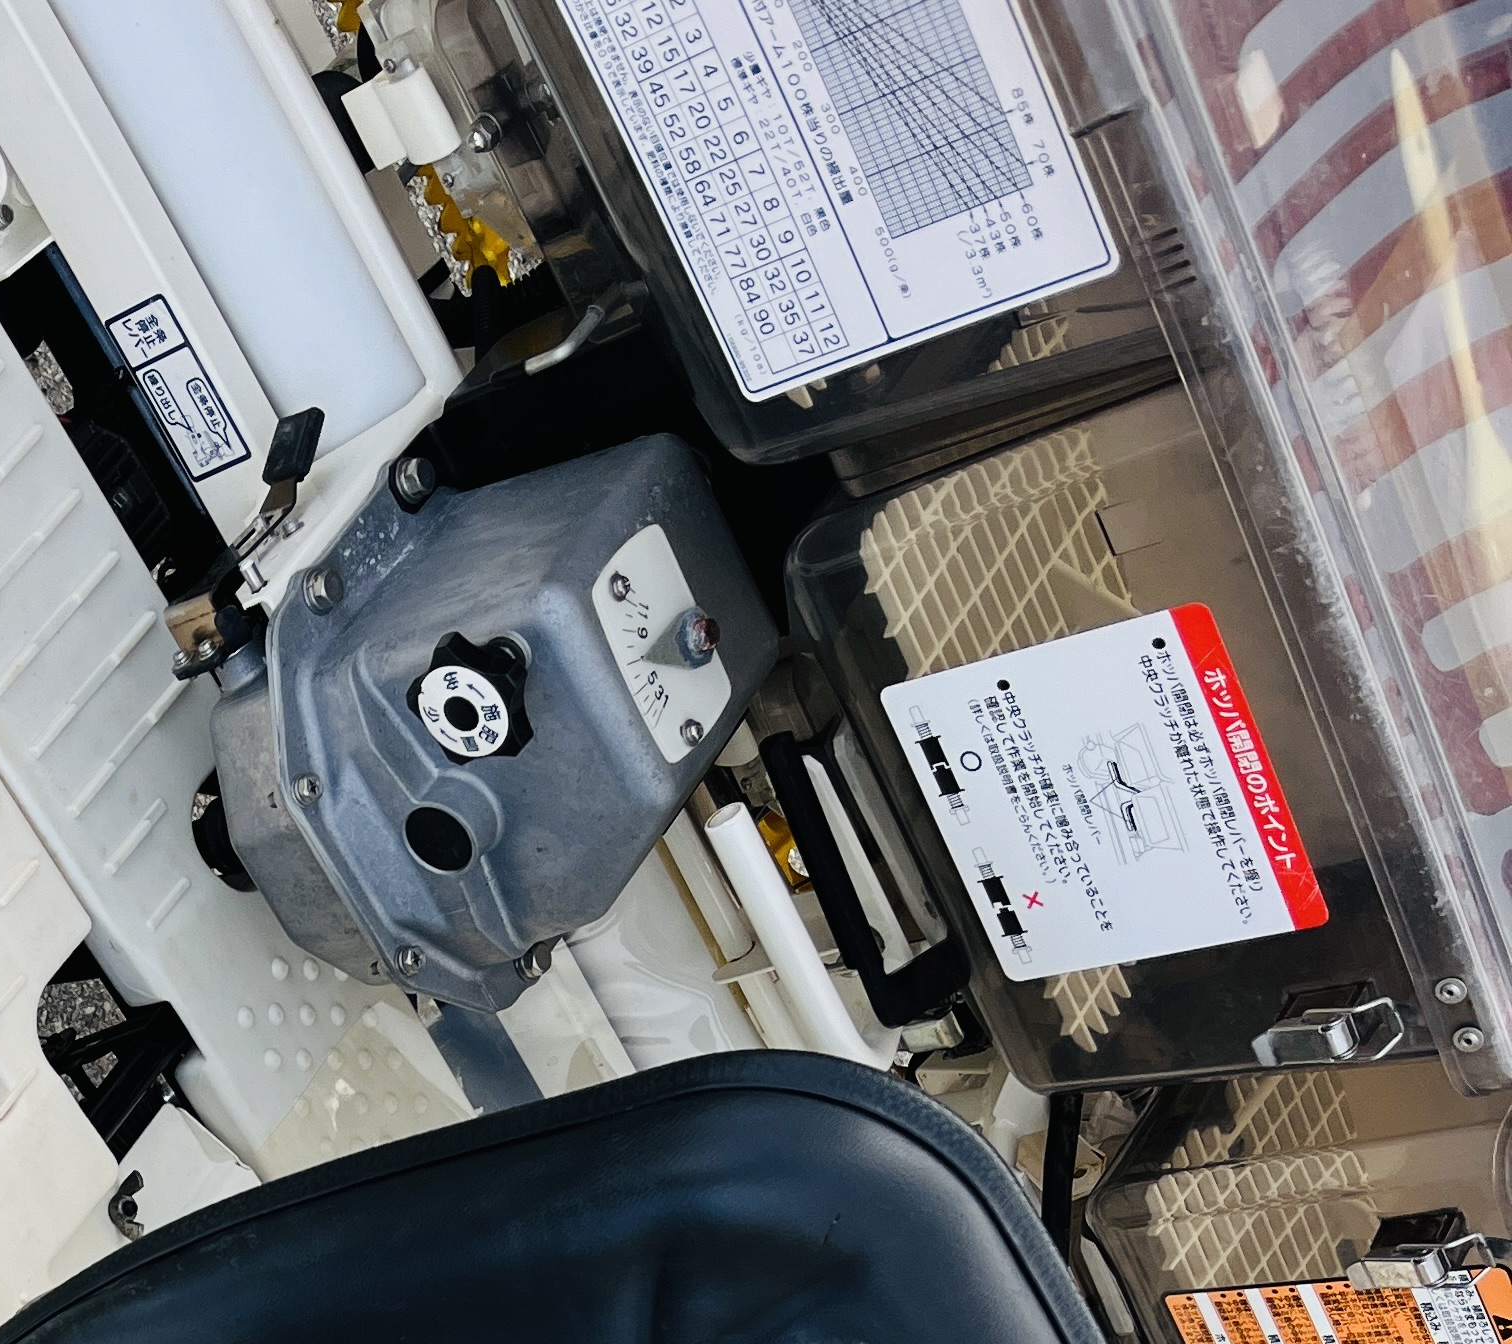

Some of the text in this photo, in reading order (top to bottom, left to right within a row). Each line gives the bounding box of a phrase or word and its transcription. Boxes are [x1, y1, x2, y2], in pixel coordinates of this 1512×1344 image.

[792, 40, 812, 71] 200
[821, 103, 840, 134] 300
[849, 166, 867, 195] 400
[1012, 88, 1054, 175] 85株 70株
[615, 12, 774, 334] 32 39 45 52 58 64 71 77 84 90
[642, 0, 814, 353] 12 15 17 20 22 25 27 30 32 35 37
[686, 29, 701, 43] 3
[703, 65, 717, 76] 4
[717, 97, 733, 110] 5
[733, 131, 748, 144] 6
[748, 163, 764, 174] 7
[763, 197, 779, 211] 8
[778, 230, 793, 243] 9
[791, 258, 811, 282] 10
[805, 291, 824, 312] 11
[819, 323, 839, 347] 12
[800, 212, 817, 236] 白色
[986, 218, 1005, 253] 43株
[1000, 211, 1020, 246] 50株
[1022, 202, 1042, 239] 60株
[970, 223, 989, 257] 37株
[121, 318, 149, 358] レバー
[135, 319, 157, 350] 停止
[144, 314, 168, 344] 全条
[190, 382, 221, 430] 全条停止
[638, 602, 649, 620] 11
[637, 626, 648, 639] 9
[443, 672, 459, 690] 多
[647, 670, 658, 685] 5
[655, 684, 664, 700] 3
[1201, 666, 1300, 871] ホッパ開閉のポイント
[983, 695, 1074, 884] 確認して作業を開始してください。
[1060, 762, 1104, 846] ホッパ開閉レバー
